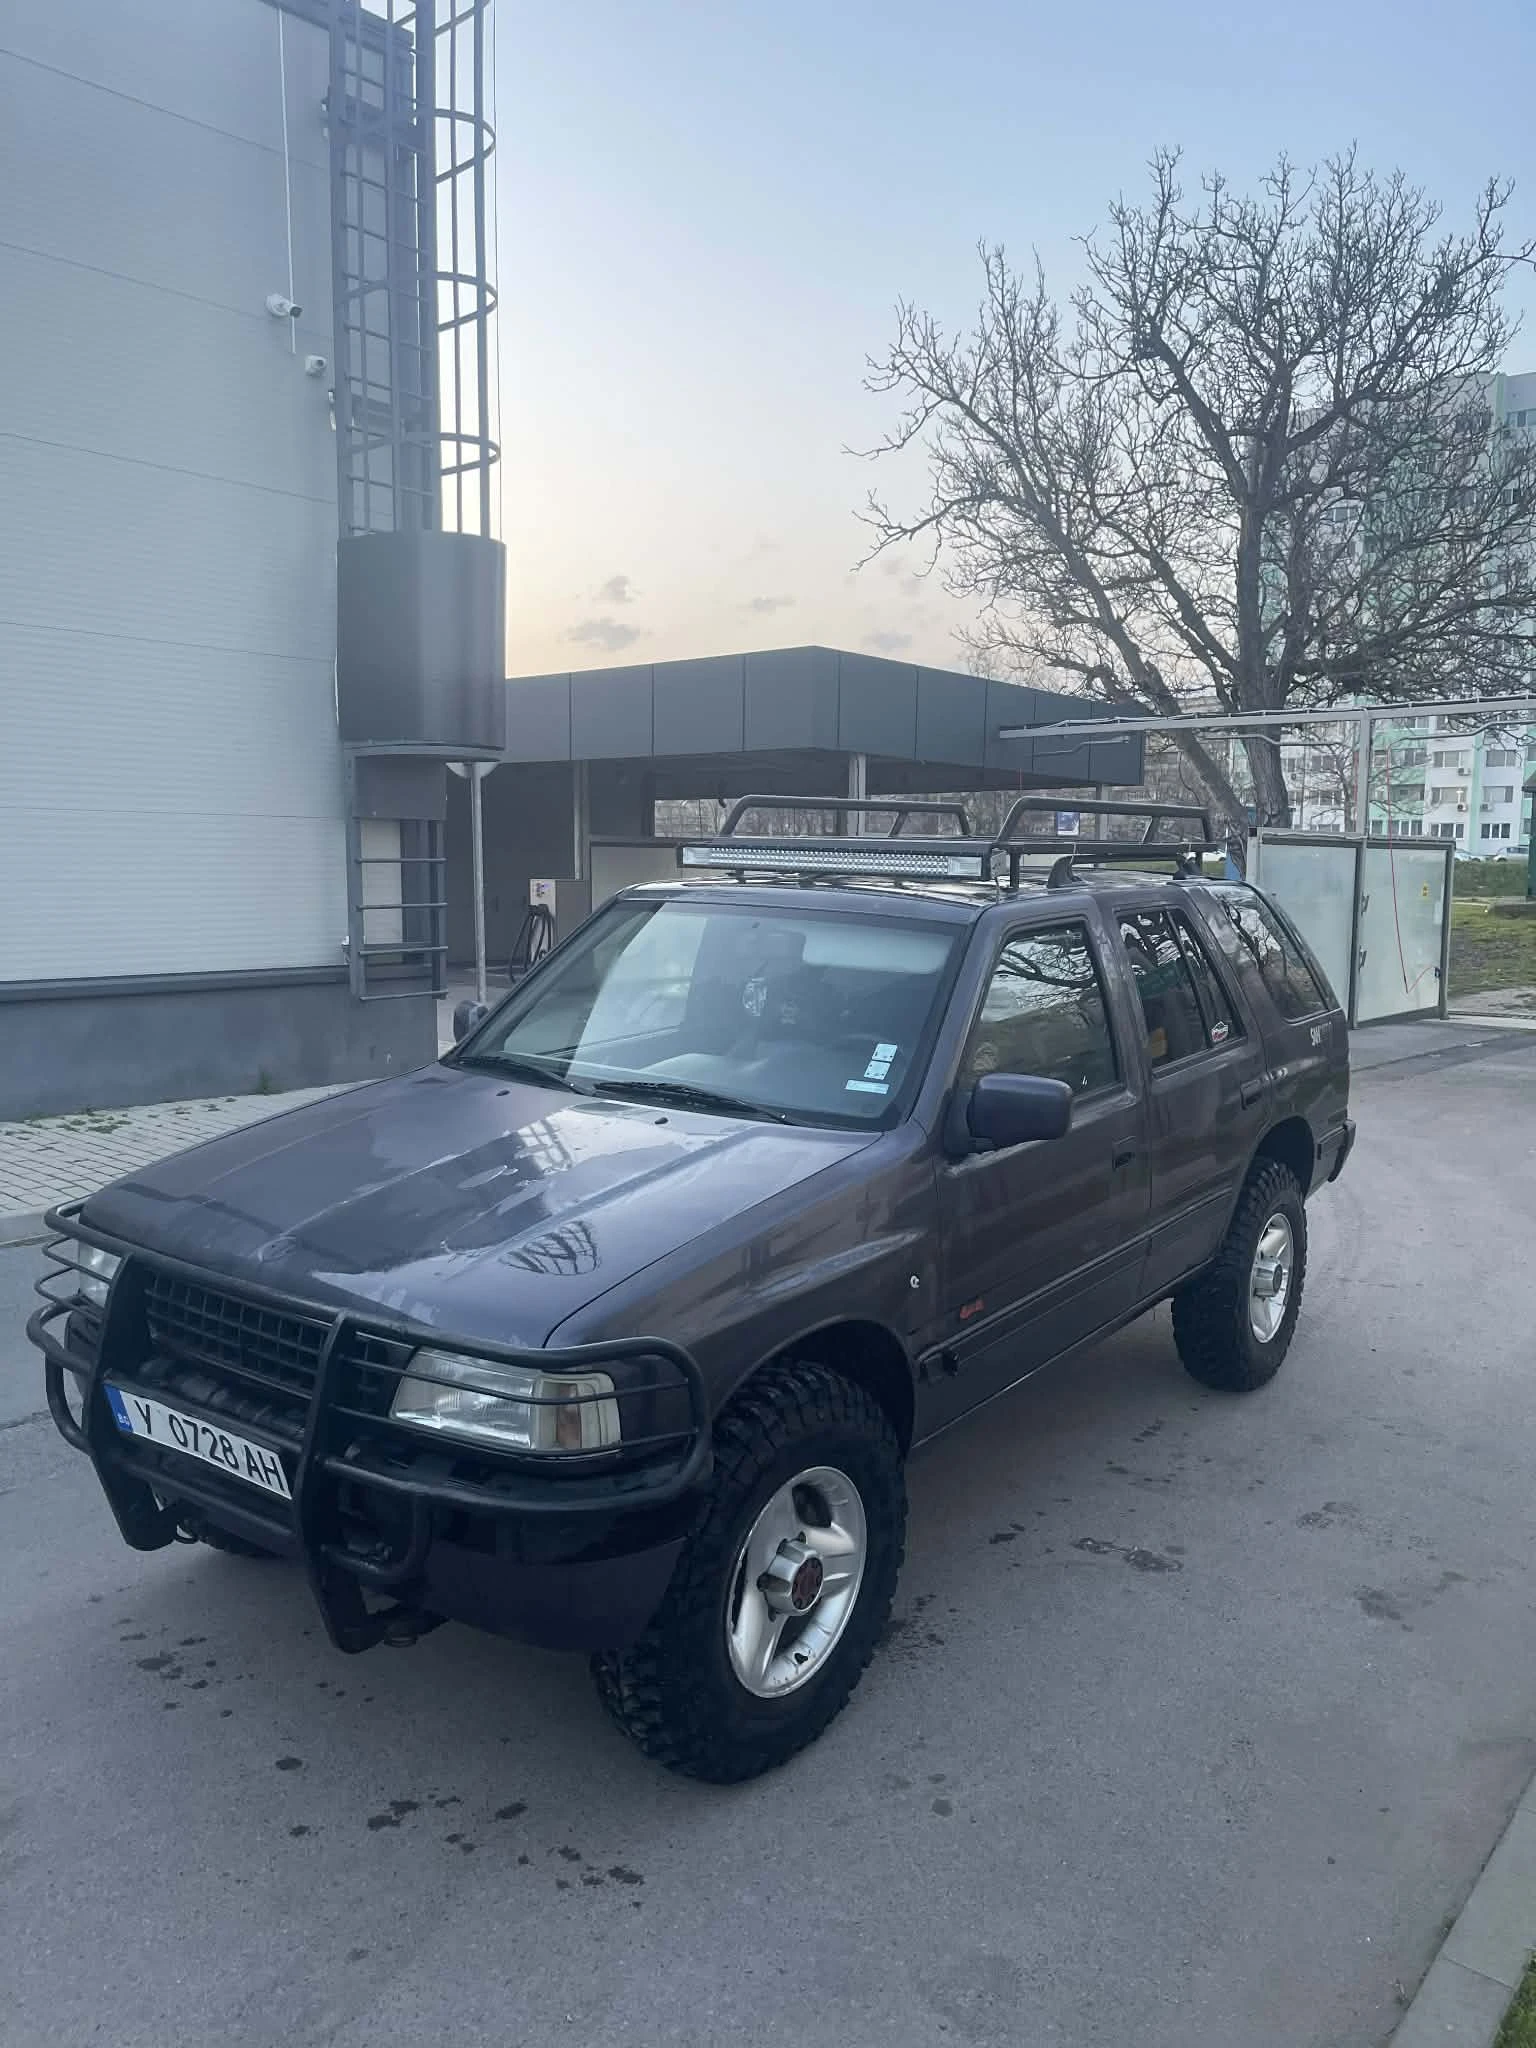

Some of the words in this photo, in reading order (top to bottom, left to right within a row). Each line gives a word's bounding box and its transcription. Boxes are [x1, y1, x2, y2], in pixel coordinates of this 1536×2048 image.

[134, 1400, 152, 1435] Y
[169, 1413, 239, 1470] 0728
[243, 1444, 286, 1491] AH
